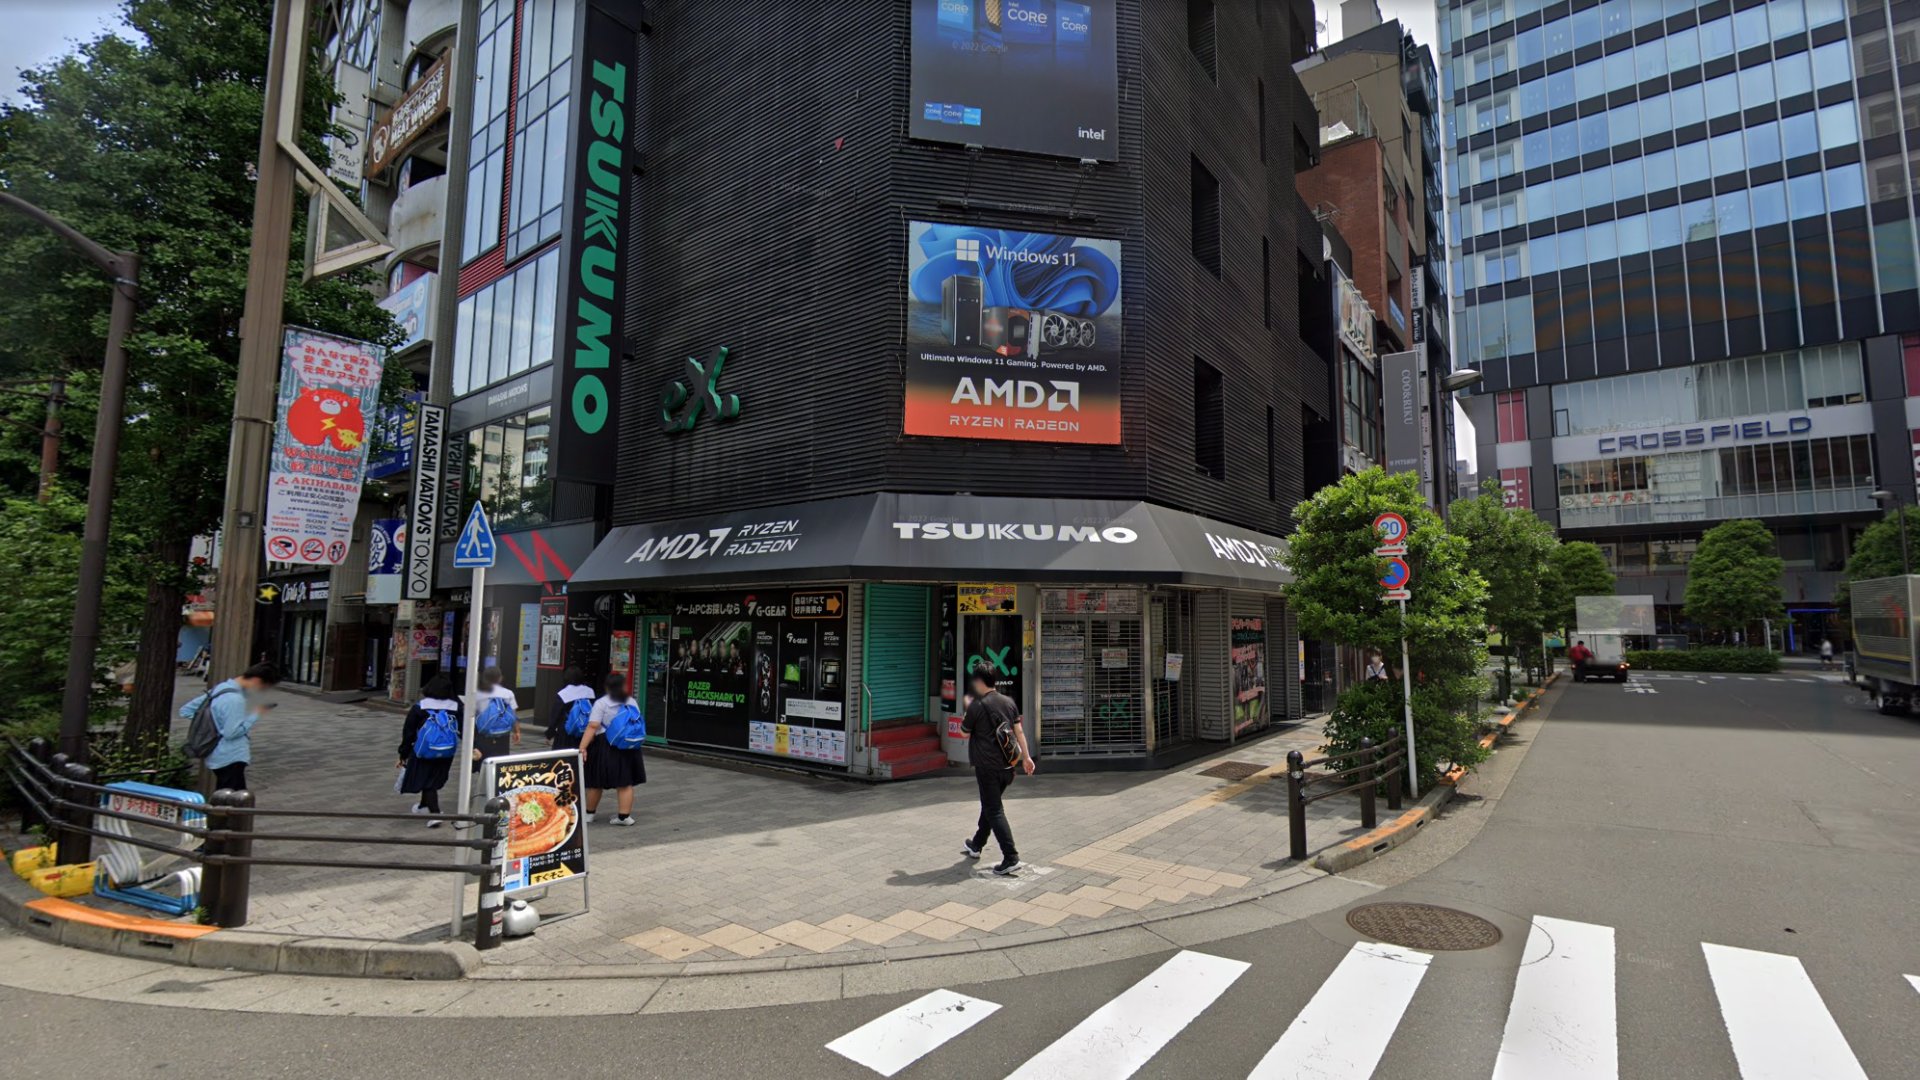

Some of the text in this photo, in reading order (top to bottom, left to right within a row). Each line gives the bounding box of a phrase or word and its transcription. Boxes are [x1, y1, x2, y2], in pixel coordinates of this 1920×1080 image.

[1078, 126, 1108, 141] intel
[572, 59, 626, 434] TSUKUMO
[986, 245, 1076, 267] Windows 11
[921, 353, 955, 363] Ultimate
[957, 355, 993, 365] Windows
[994, 358, 1005, 366] 11
[1006, 359, 1039, 369] Gaming.
[1041, 361, 1074, 371] Powered
[1075, 363, 1086, 372] by
[950, 376, 1045, 408] AMD
[949, 415, 1080, 432] RYZEN RADEON
[1598, 416, 1812, 453] CROSS FIELD
[421, 408, 440, 474] TAMASHII
[291, 476, 359, 494] AKIHABARA
[416, 471, 436, 535] NATIONS
[737, 519, 800, 538] RYZEN
[892, 521, 1138, 545] TSUKUMO
[624, 533, 701, 564] AMD
[723, 538, 799, 557] RADEON
[1204, 532, 1257, 564] AMD
[411, 536, 431, 593] TOKYO
[687, 680, 711, 691] RAZER
[687, 689, 745, 703] BLACKSHARK V2
